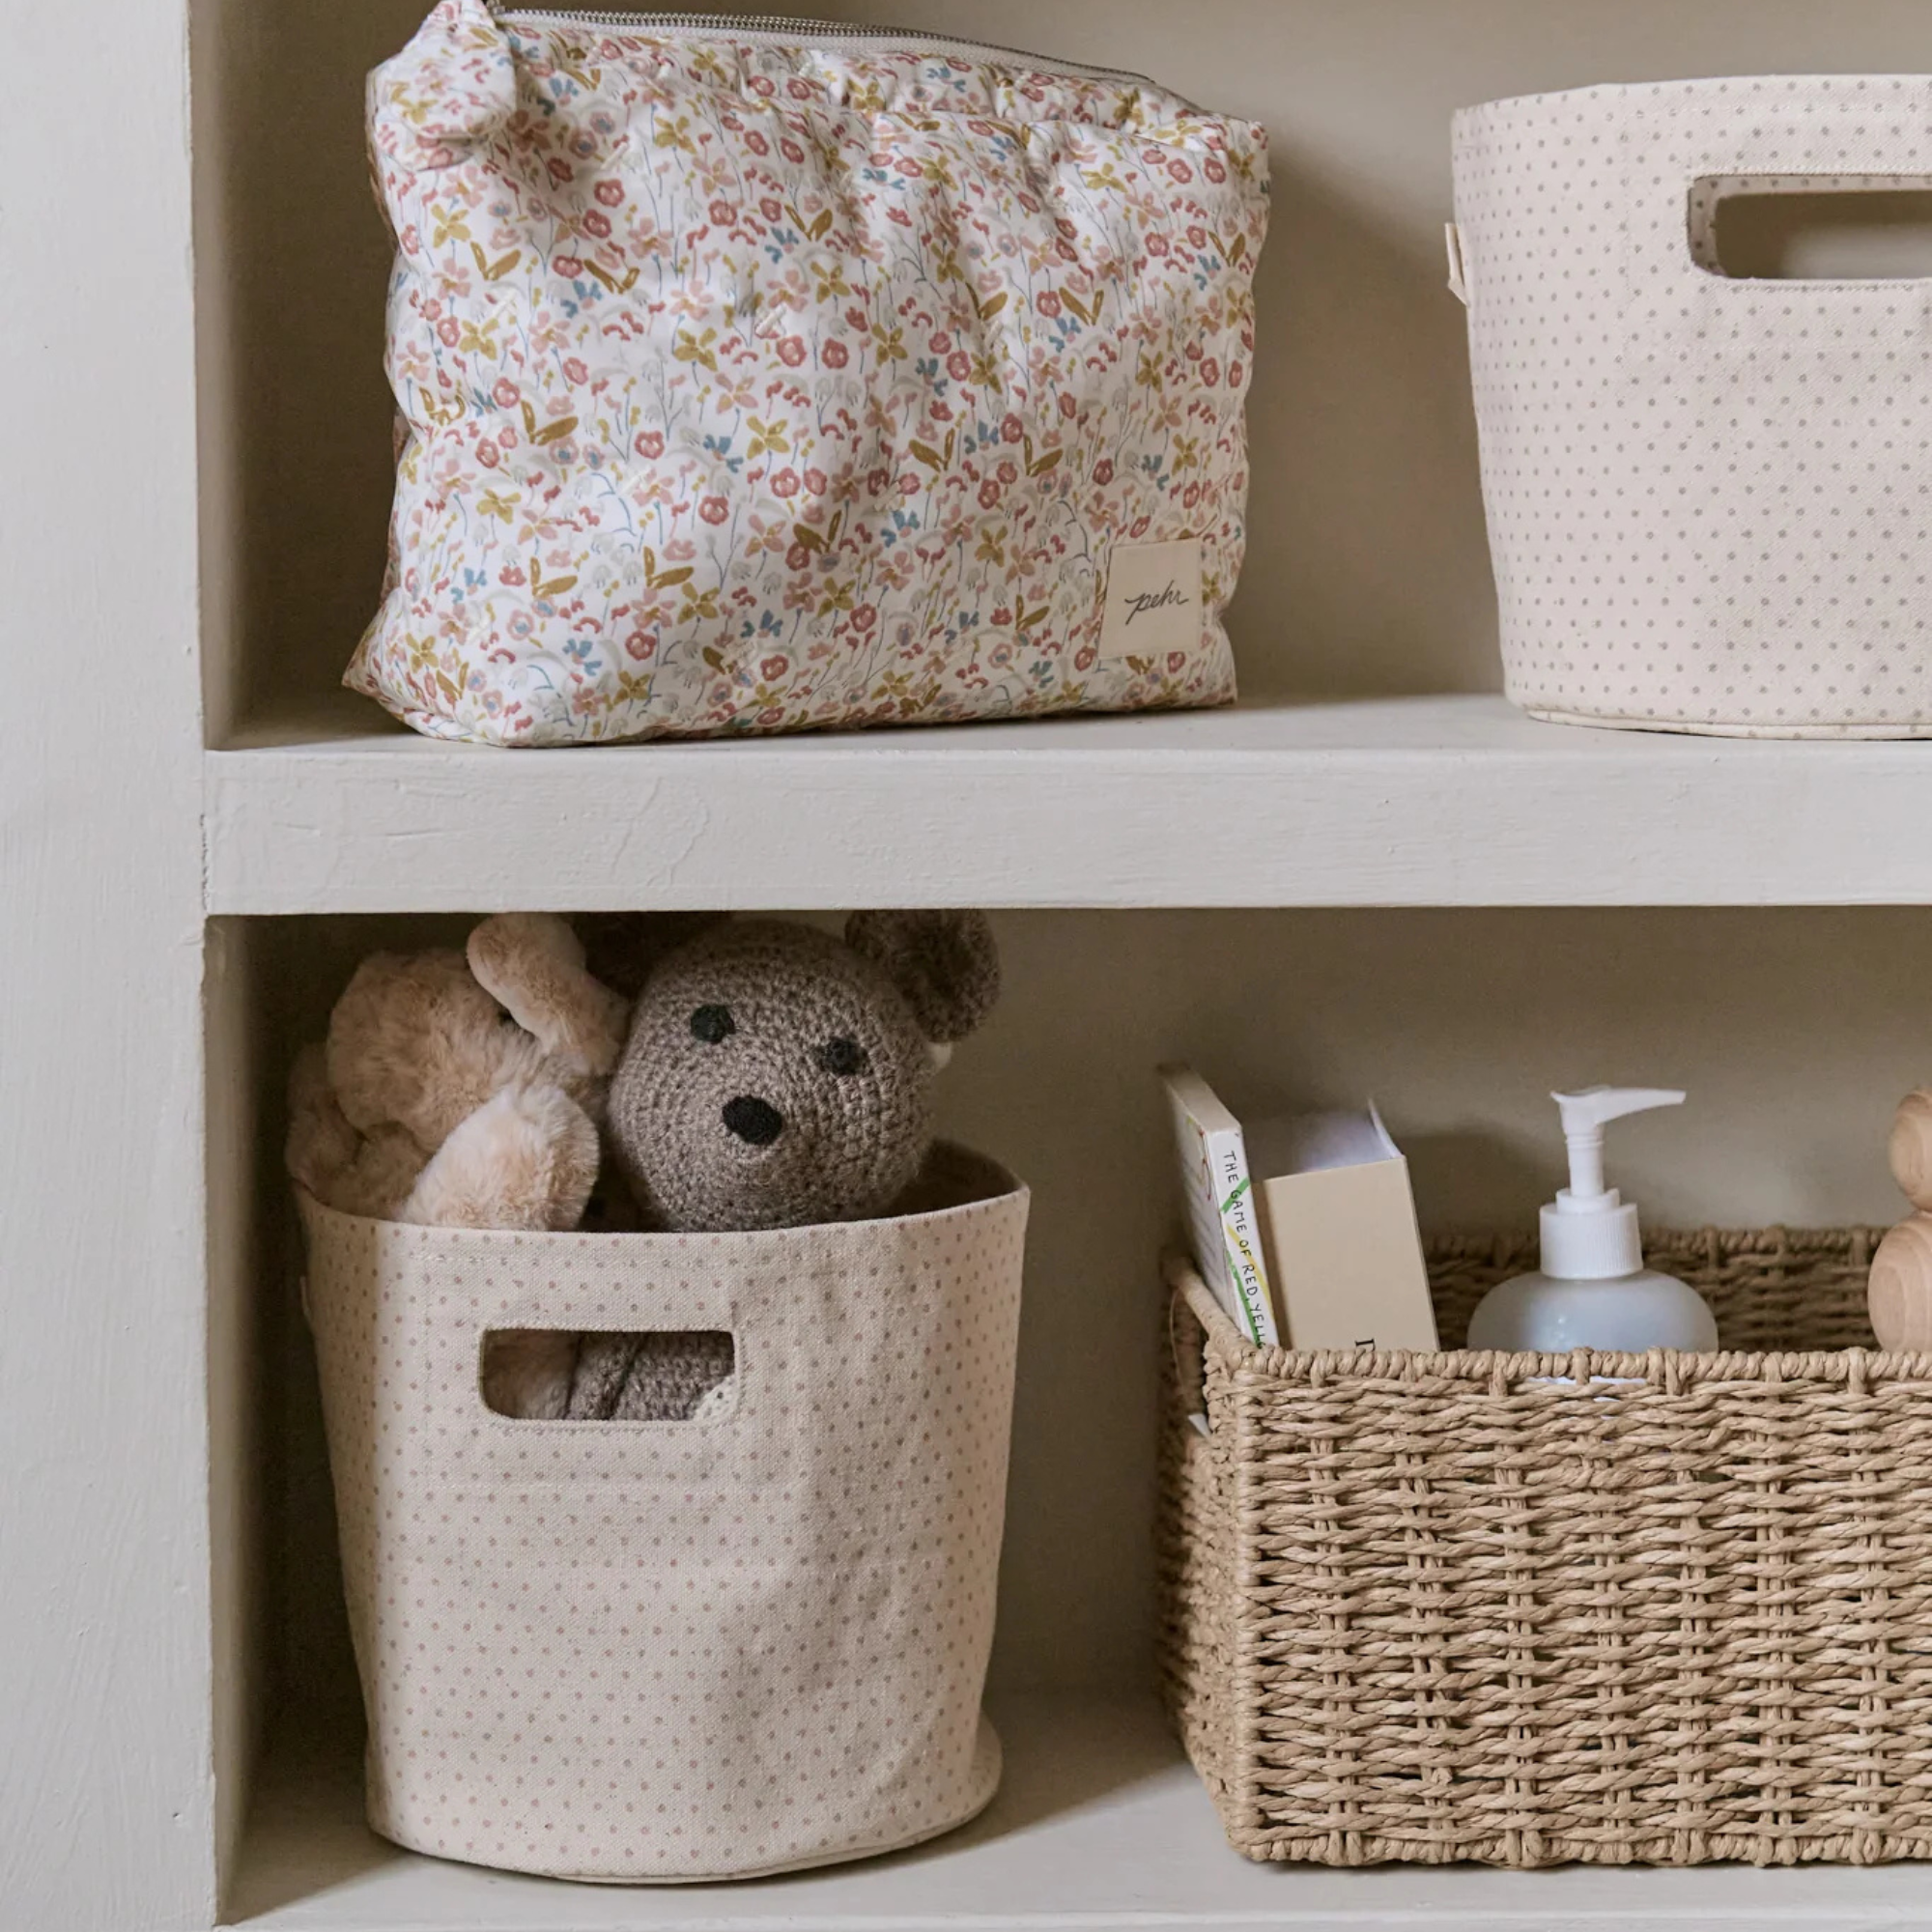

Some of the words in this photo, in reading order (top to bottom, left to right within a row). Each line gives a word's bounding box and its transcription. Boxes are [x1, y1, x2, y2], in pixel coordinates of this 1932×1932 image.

[1124, 580, 1189, 625] pehr
[1224, 1151, 1238, 1183] THE
[1231, 1189, 1247, 1233] GAME
[1239, 1239, 1252, 1257] OF
[1243, 1264, 1259, 1302] RED,
